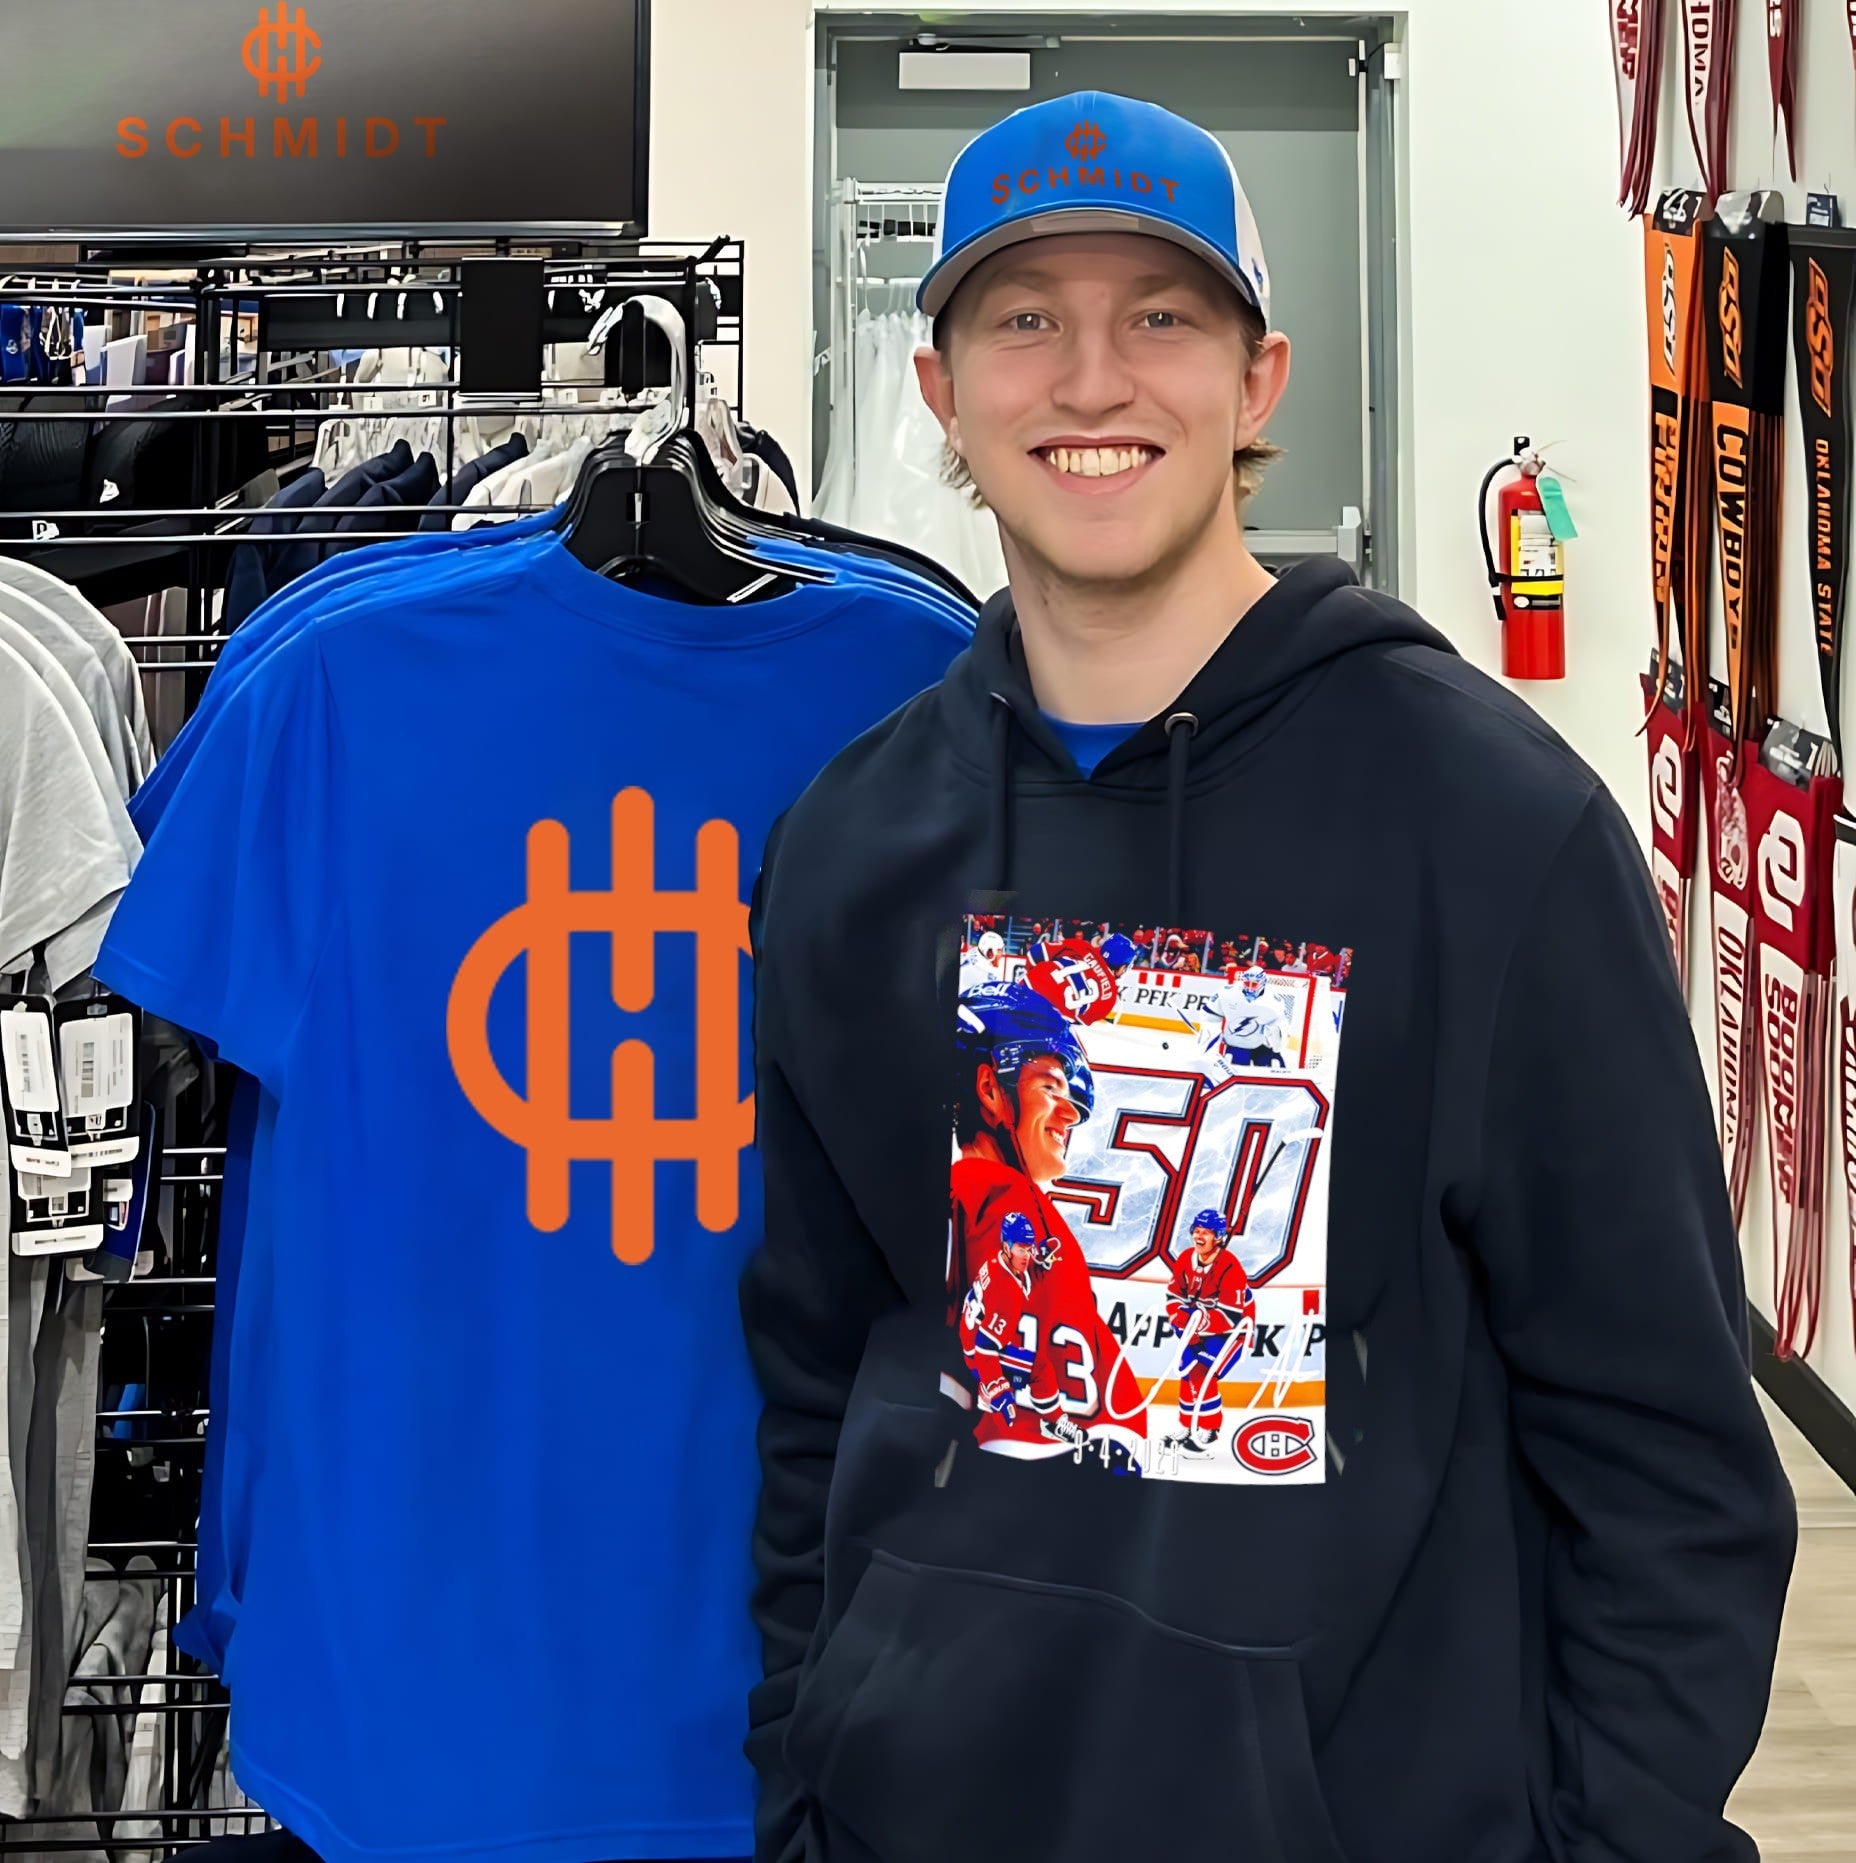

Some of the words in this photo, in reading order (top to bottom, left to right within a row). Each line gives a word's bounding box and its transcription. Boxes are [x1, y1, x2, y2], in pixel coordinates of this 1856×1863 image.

[115, 117, 448, 159] SCHMIDT
[991, 167, 1179, 205] SCHMIDT
[1815, 438, 1832, 571] OKLAHOMA
[968, 982, 1009, 997] Bell
[1134, 987, 1175, 1008] PFK
[1719, 926, 1745, 1144] OKLAHOMA
[1777, 984, 1799, 1204] BOO
[1048, 1062, 1330, 1289] 50
[987, 1312, 1007, 1336] 13
[1016, 1313, 1100, 1418] 13
